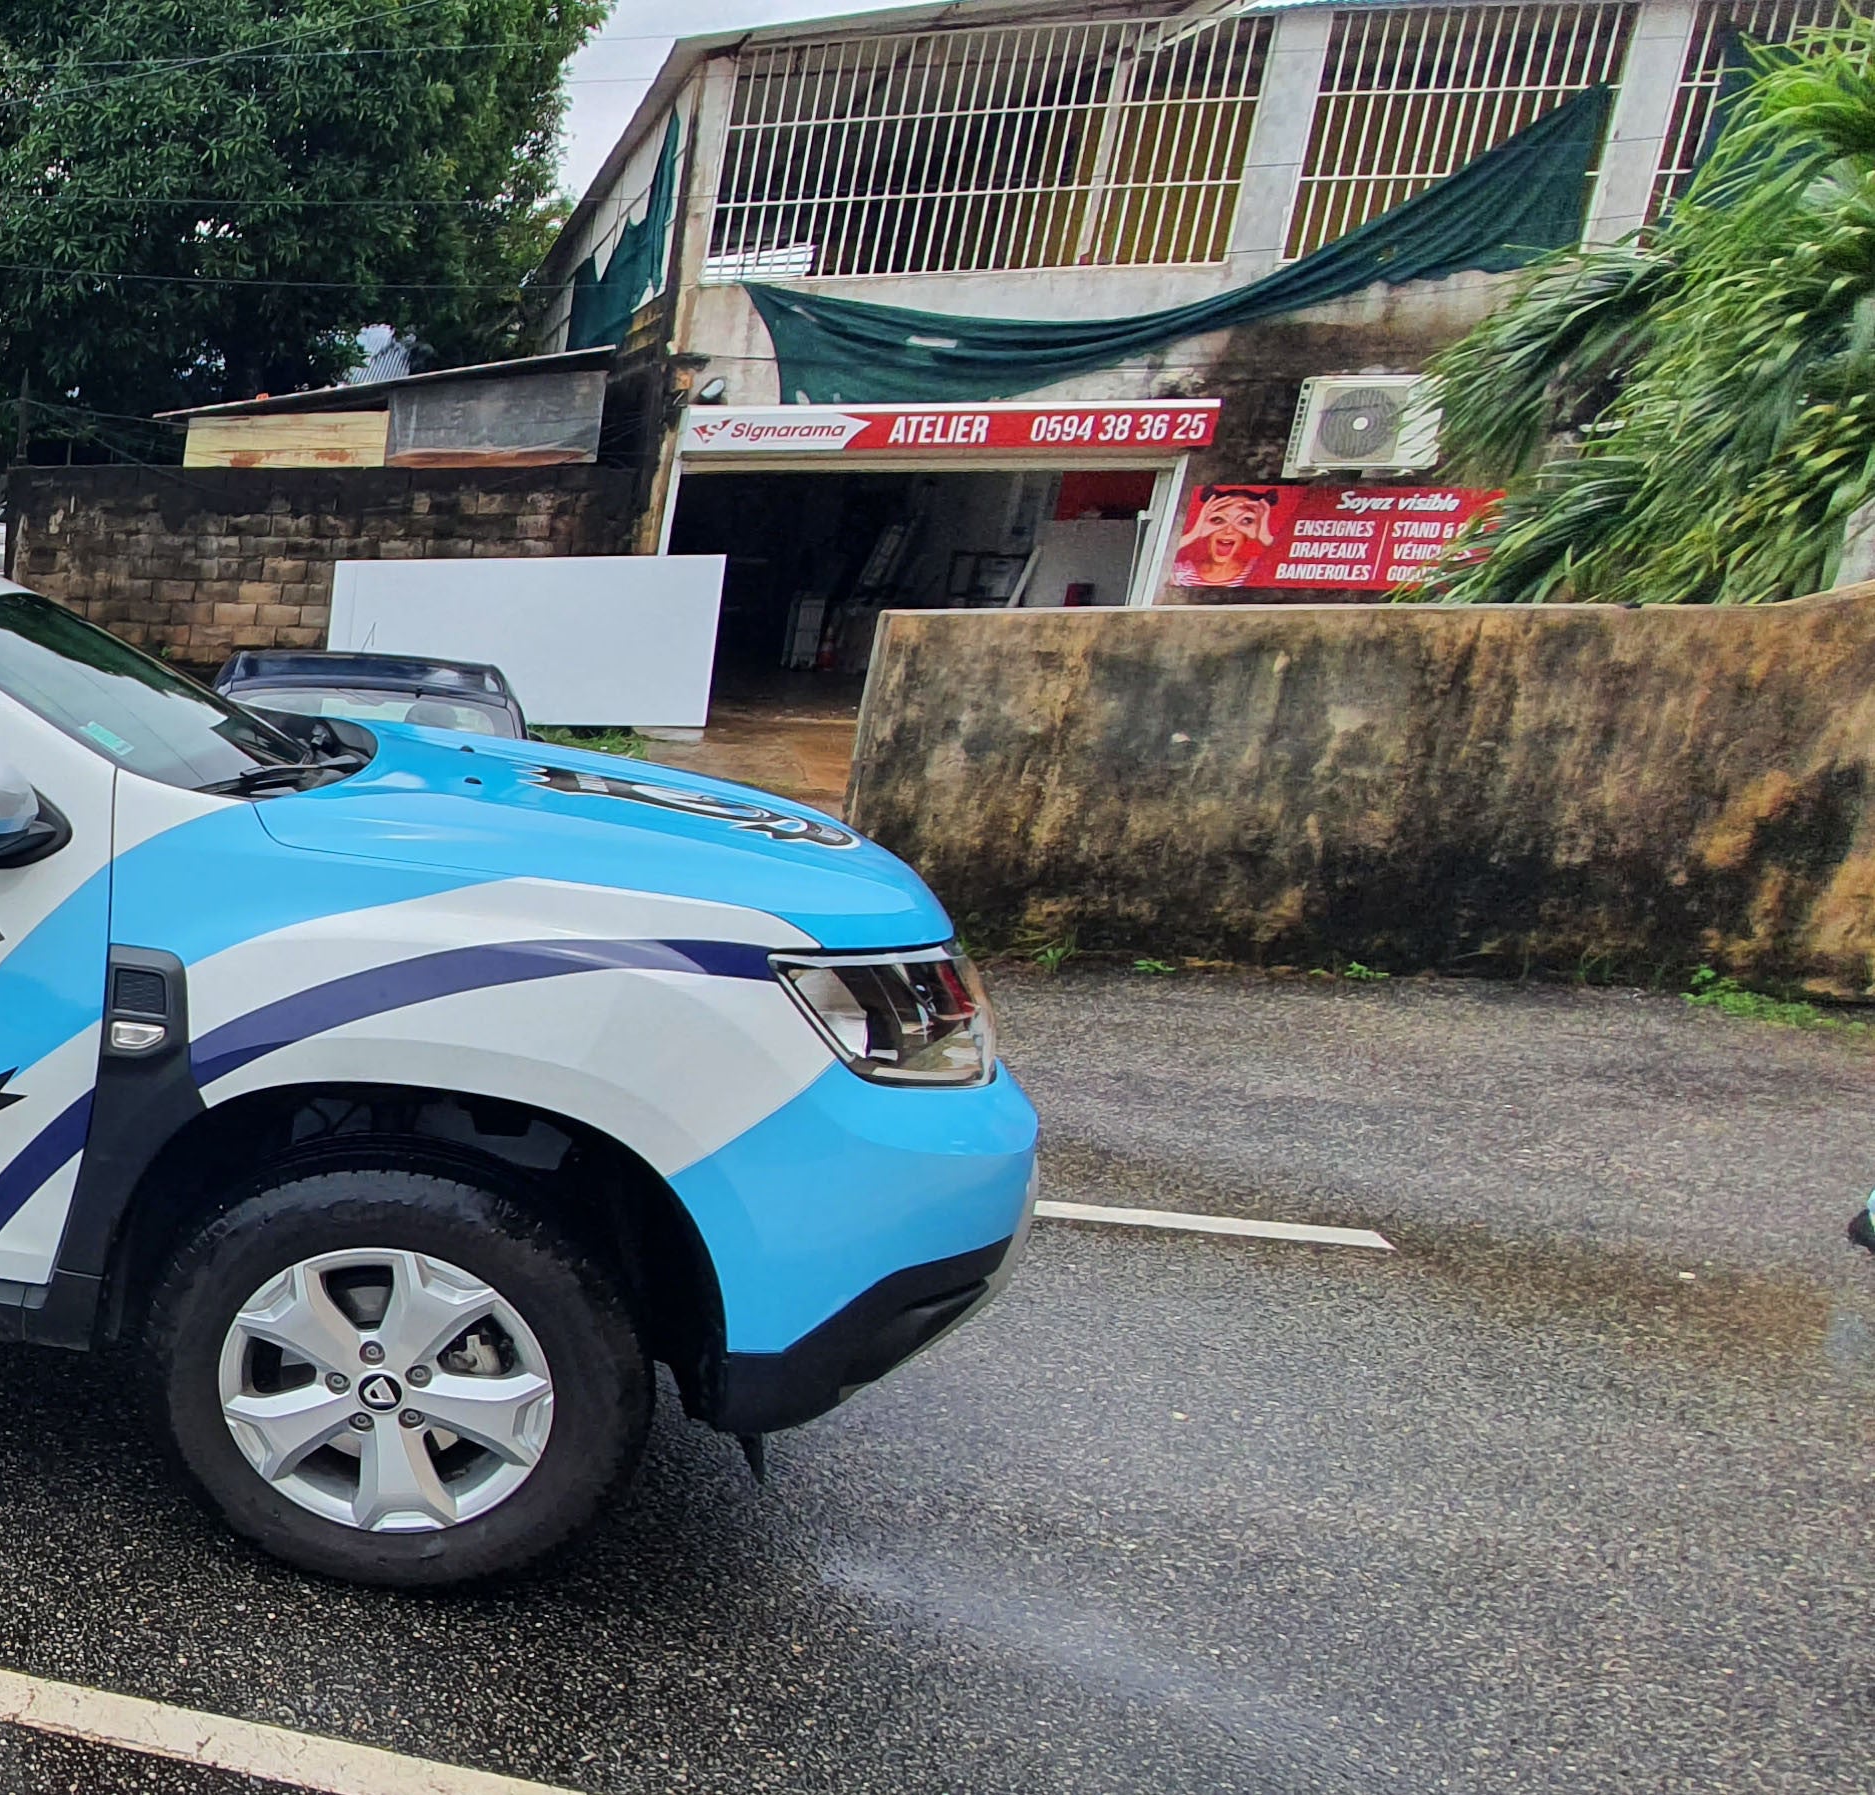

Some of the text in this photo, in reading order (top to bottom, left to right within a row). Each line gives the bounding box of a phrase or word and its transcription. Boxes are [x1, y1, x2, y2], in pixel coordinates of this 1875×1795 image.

[730, 422, 847, 442] Signarama
[887, 412, 1208, 444] ATELIER 0594 38 36 25
[1336, 490, 1461, 515] Soyez visible
[1293, 519, 1376, 538] ENSEIGNES
[1391, 520, 1441, 539] STAND
[1442, 521, 1454, 539] &
[1289, 541, 1368, 560] DRAPEAUX
[1275, 562, 1373, 581] BANDEROLES
